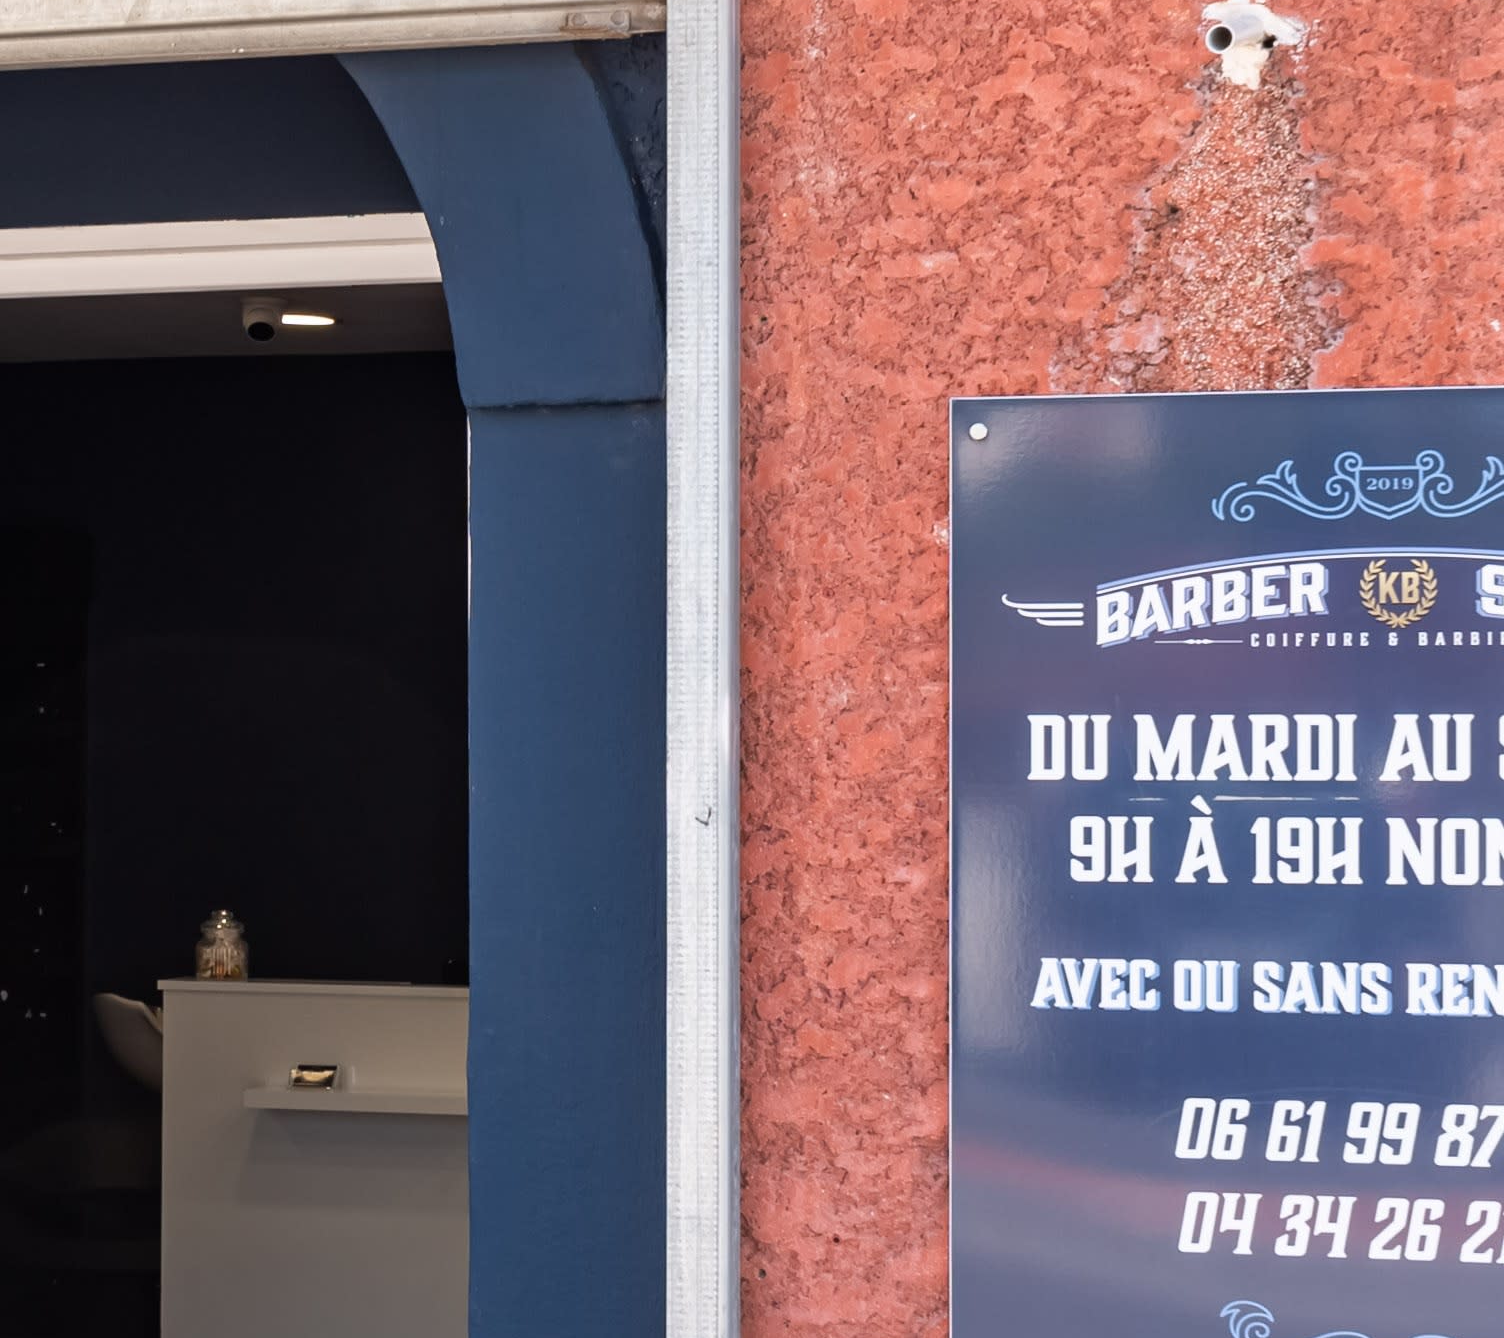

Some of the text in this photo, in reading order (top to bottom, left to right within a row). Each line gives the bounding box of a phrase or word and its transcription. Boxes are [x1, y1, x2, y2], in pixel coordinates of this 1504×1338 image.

[1366, 476, 1415, 492] 2019
[1096, 562, 1328, 647] BARBER
[1379, 569, 1421, 605] KB
[1250, 632, 1369, 648] COIFFURE
[1388, 632, 1399, 647] &
[1027, 714, 1112, 781] DU
[1133, 714, 1358, 782] MARDI
[1378, 714, 1474, 782] AU
[1069, 816, 1154, 883] 9H
[1175, 795, 1230, 884] À
[1250, 816, 1364, 885] 19H
[1030, 957, 1160, 1011] AVEC
[1173, 959, 1239, 1012] OU
[1253, 960, 1392, 1016] SANS
[1174, 1097, 1251, 1161] 06
[1265, 1099, 1327, 1163] 61
[1342, 1101, 1421, 1166] 99
[1178, 1191, 1260, 1255] 04
[1274, 1194, 1358, 1259] 34
[1368, 1197, 1445, 1262] 26
